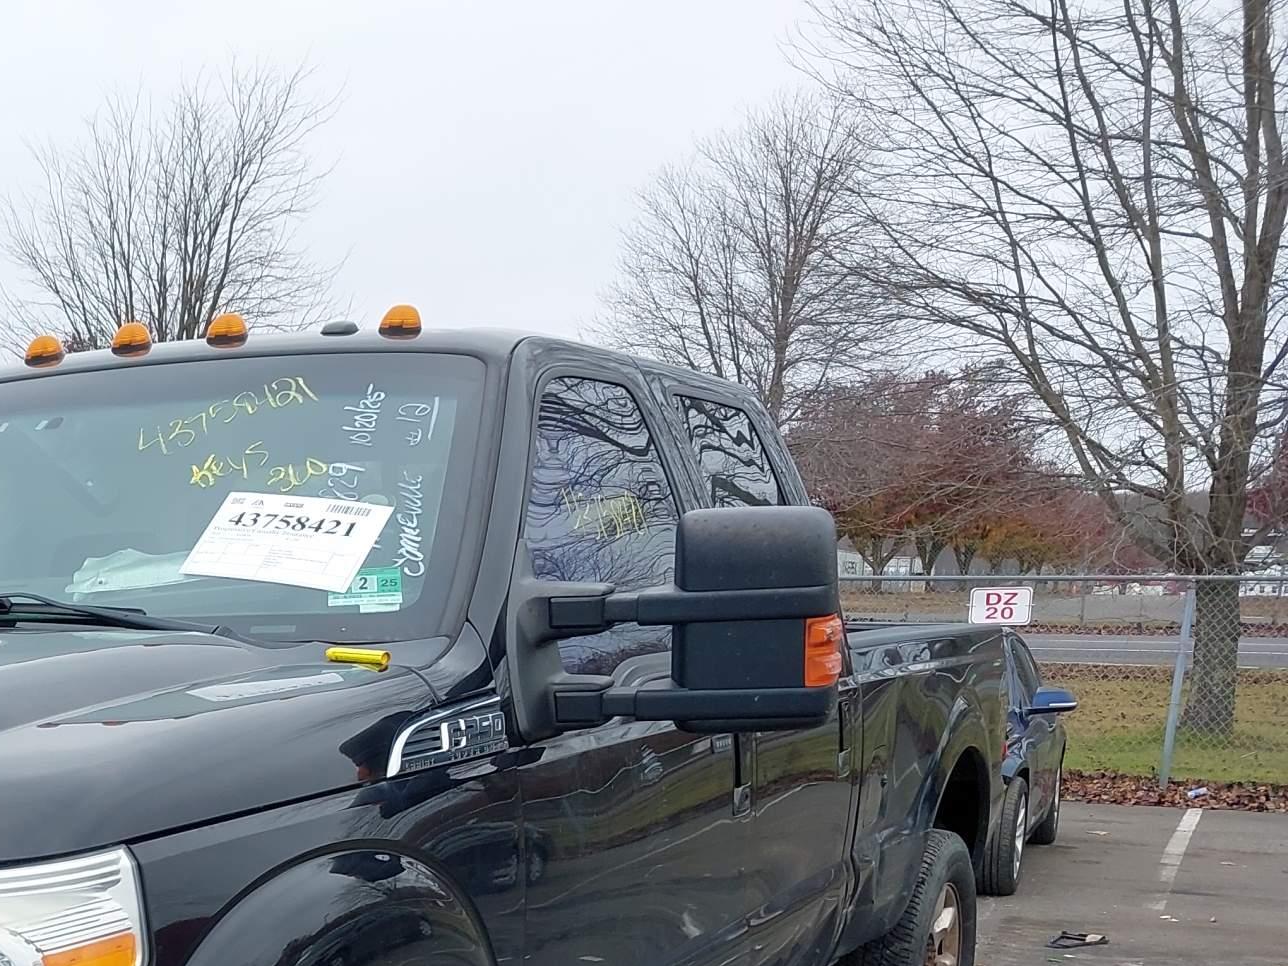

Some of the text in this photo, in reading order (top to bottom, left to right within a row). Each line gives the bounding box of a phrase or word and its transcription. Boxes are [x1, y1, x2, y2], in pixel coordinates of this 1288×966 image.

[138, 376, 320, 455] 43758421
[228, 511, 357, 537] 43758421
[358, 577, 398, 590] 2 25
[985, 592, 1018, 606] DZ
[985, 606, 1014, 620] 20
